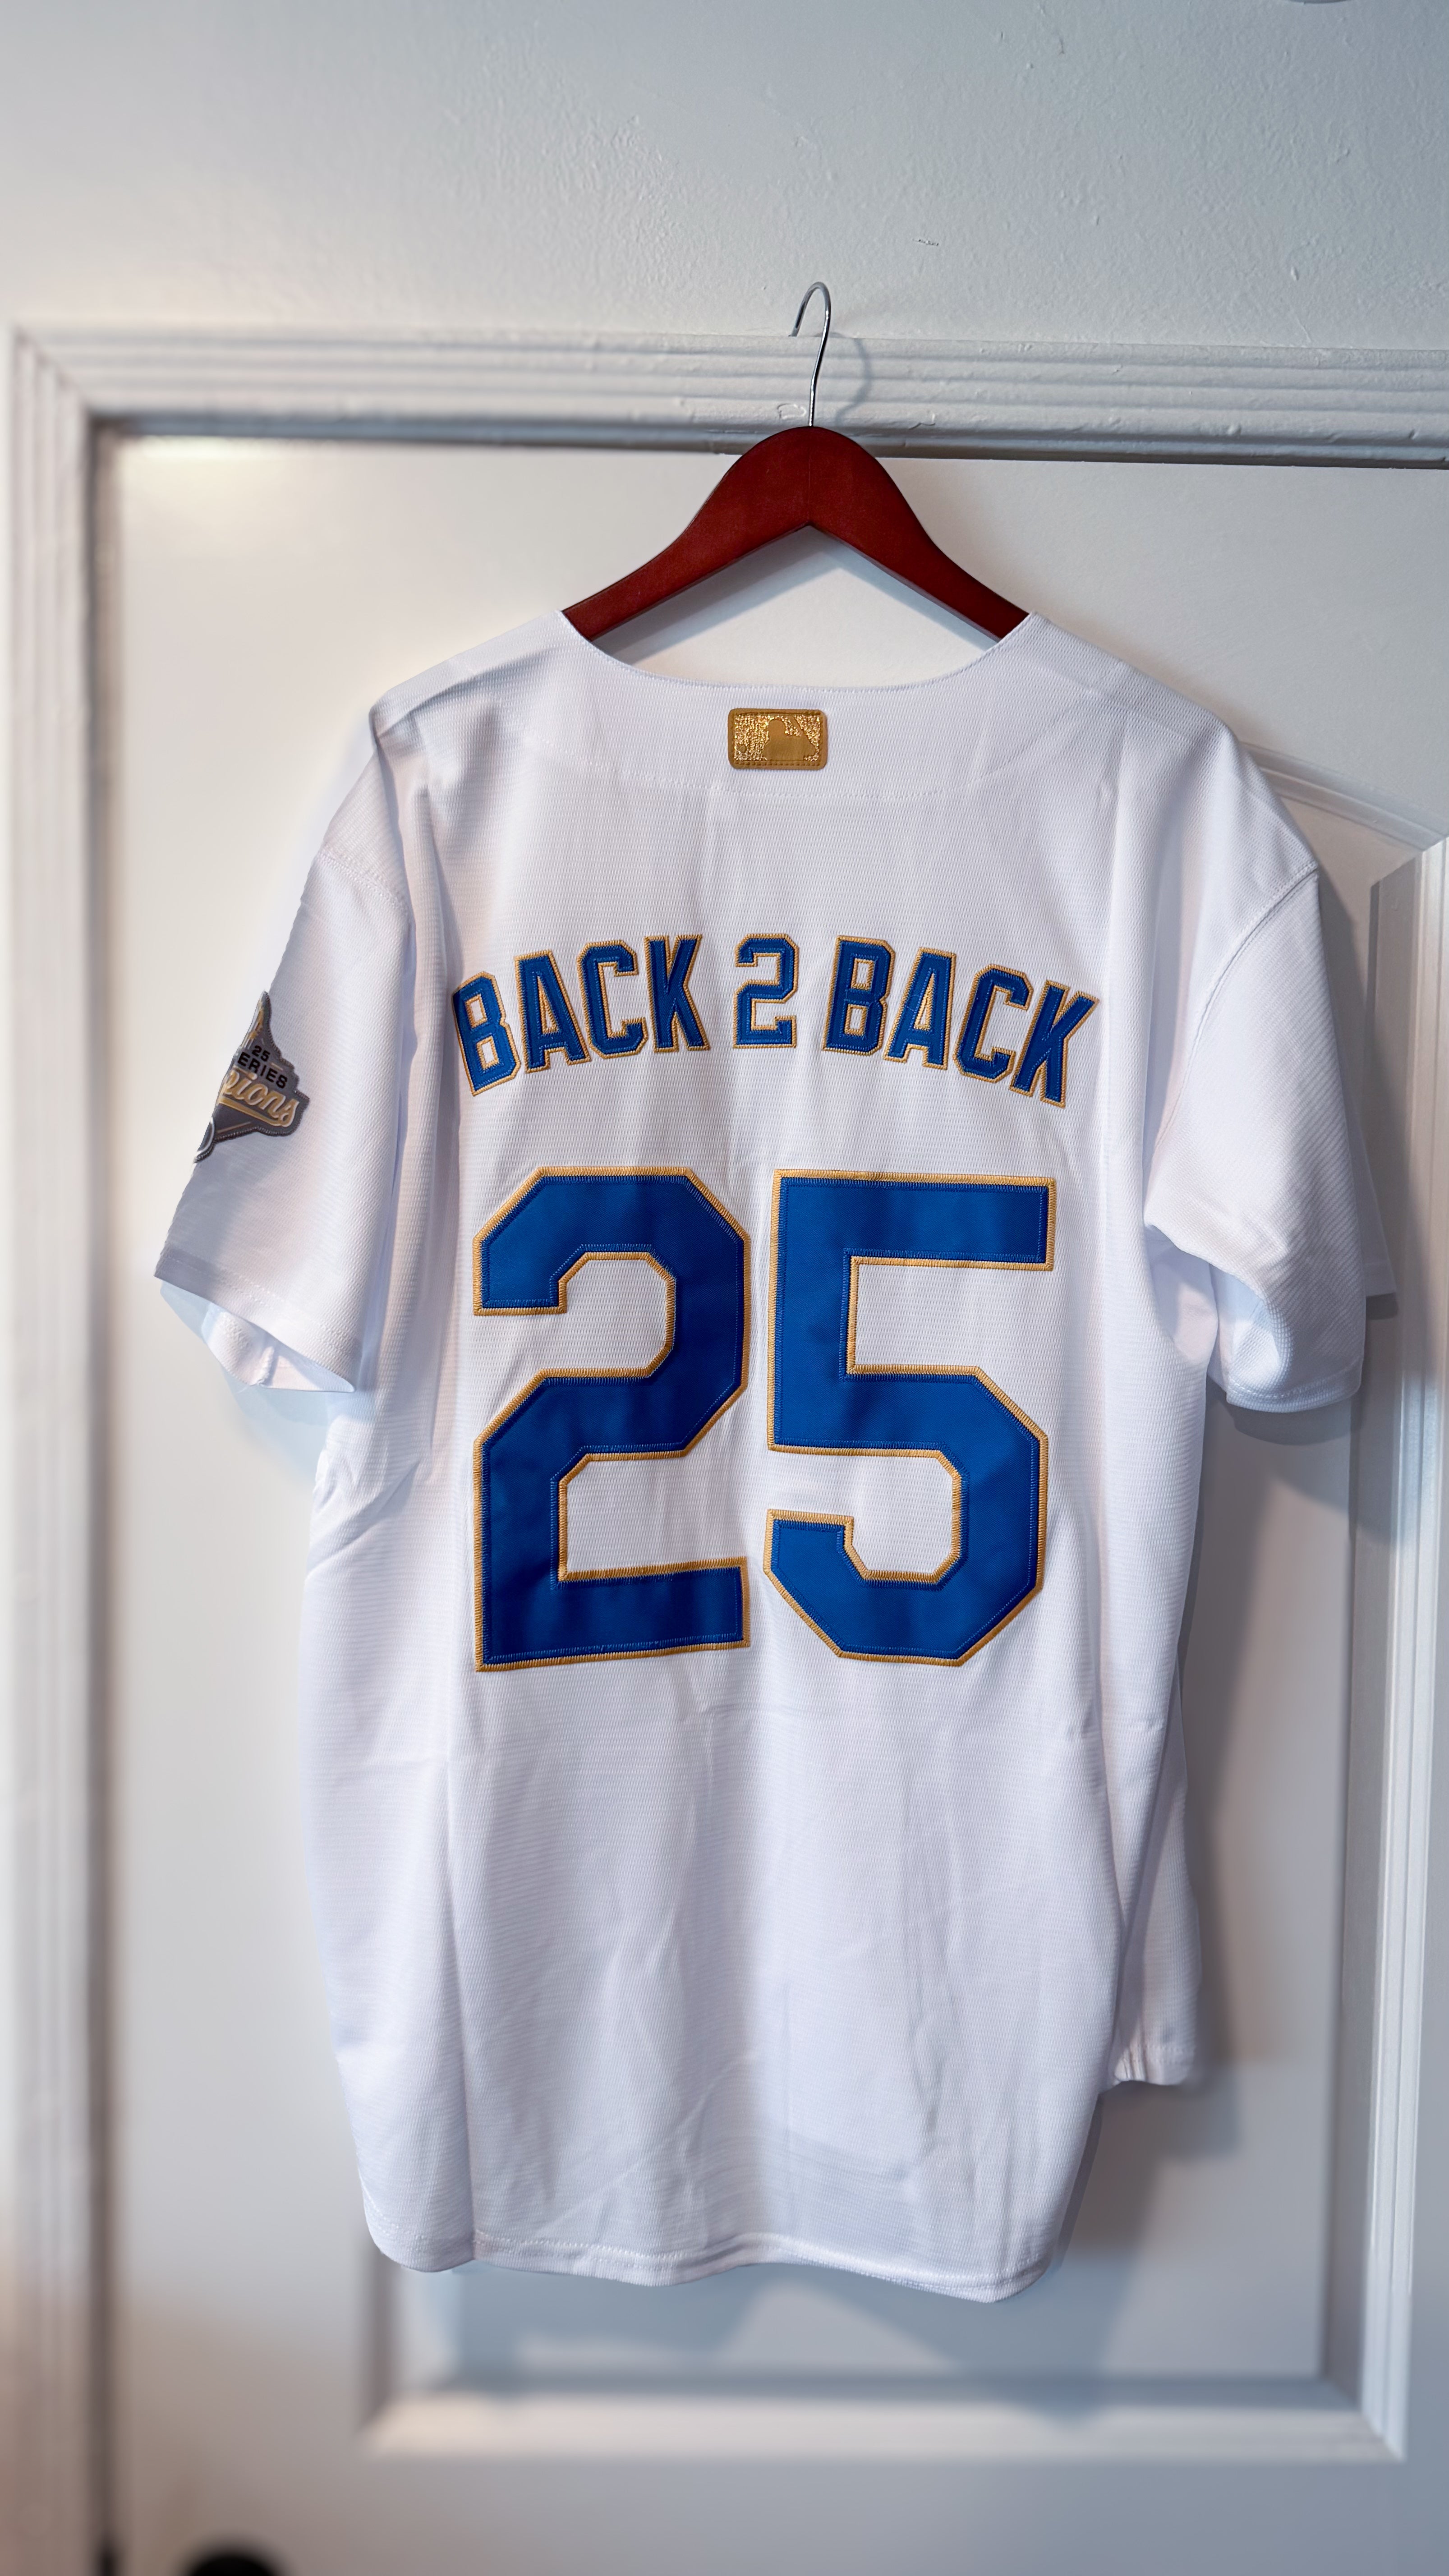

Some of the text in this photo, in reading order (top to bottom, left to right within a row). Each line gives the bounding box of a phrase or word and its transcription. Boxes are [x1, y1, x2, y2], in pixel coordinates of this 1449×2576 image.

[453, 933, 1099, 1108] BACK 2 BACK
[473, 1166, 1056, 1672] 25
